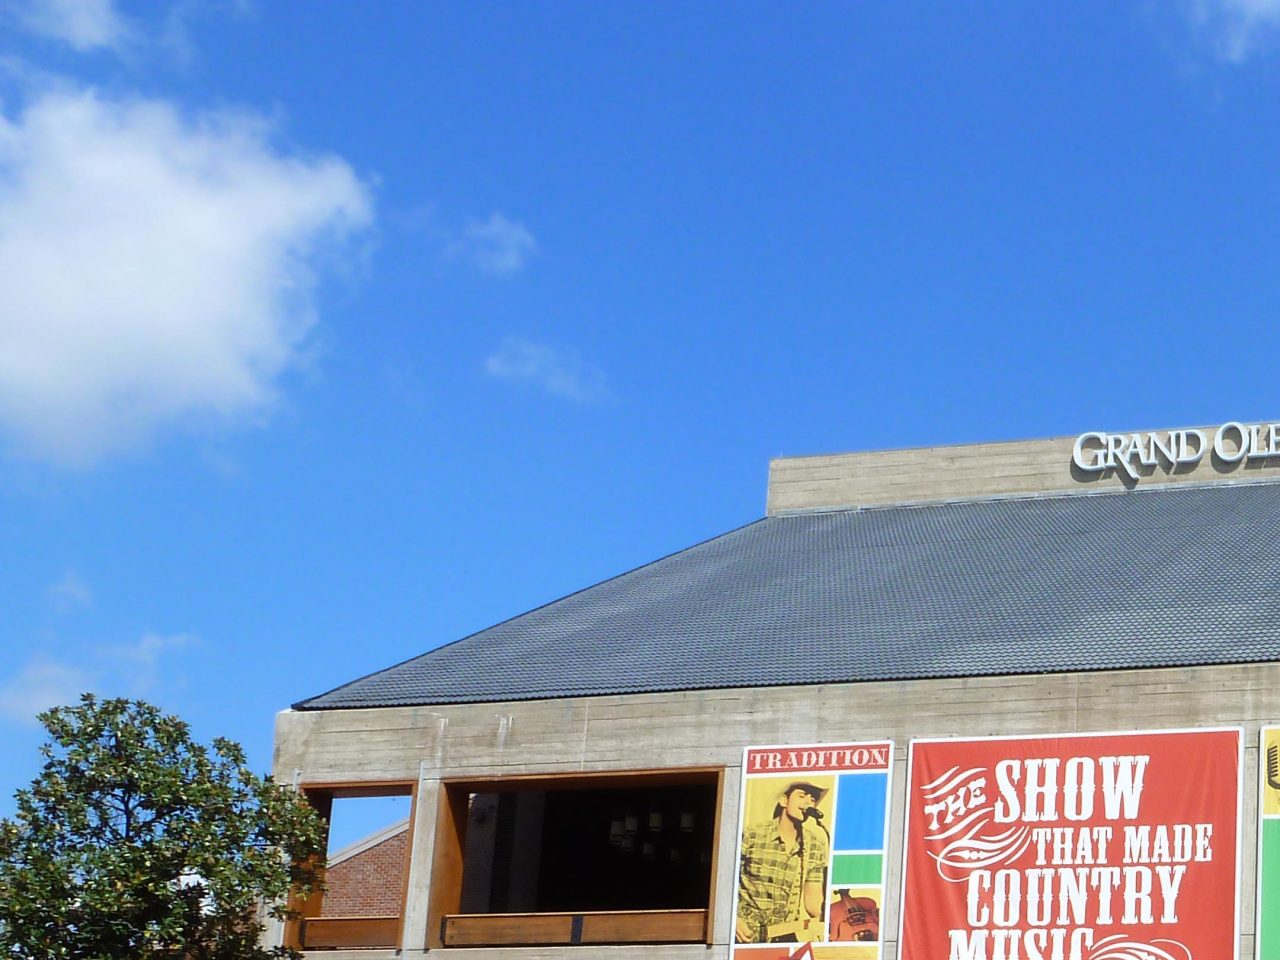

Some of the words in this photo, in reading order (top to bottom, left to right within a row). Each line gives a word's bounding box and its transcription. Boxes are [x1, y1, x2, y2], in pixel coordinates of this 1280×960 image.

[1073, 430, 1206, 479] GRAND
[750, 747, 888, 771] TRADITION
[924, 776, 987, 831] THE
[994, 755, 1150, 823] SHOW
[1032, 826, 1112, 866] THAT
[1123, 823, 1214, 864] MADE
[967, 865, 1187, 927] COUNTRY
